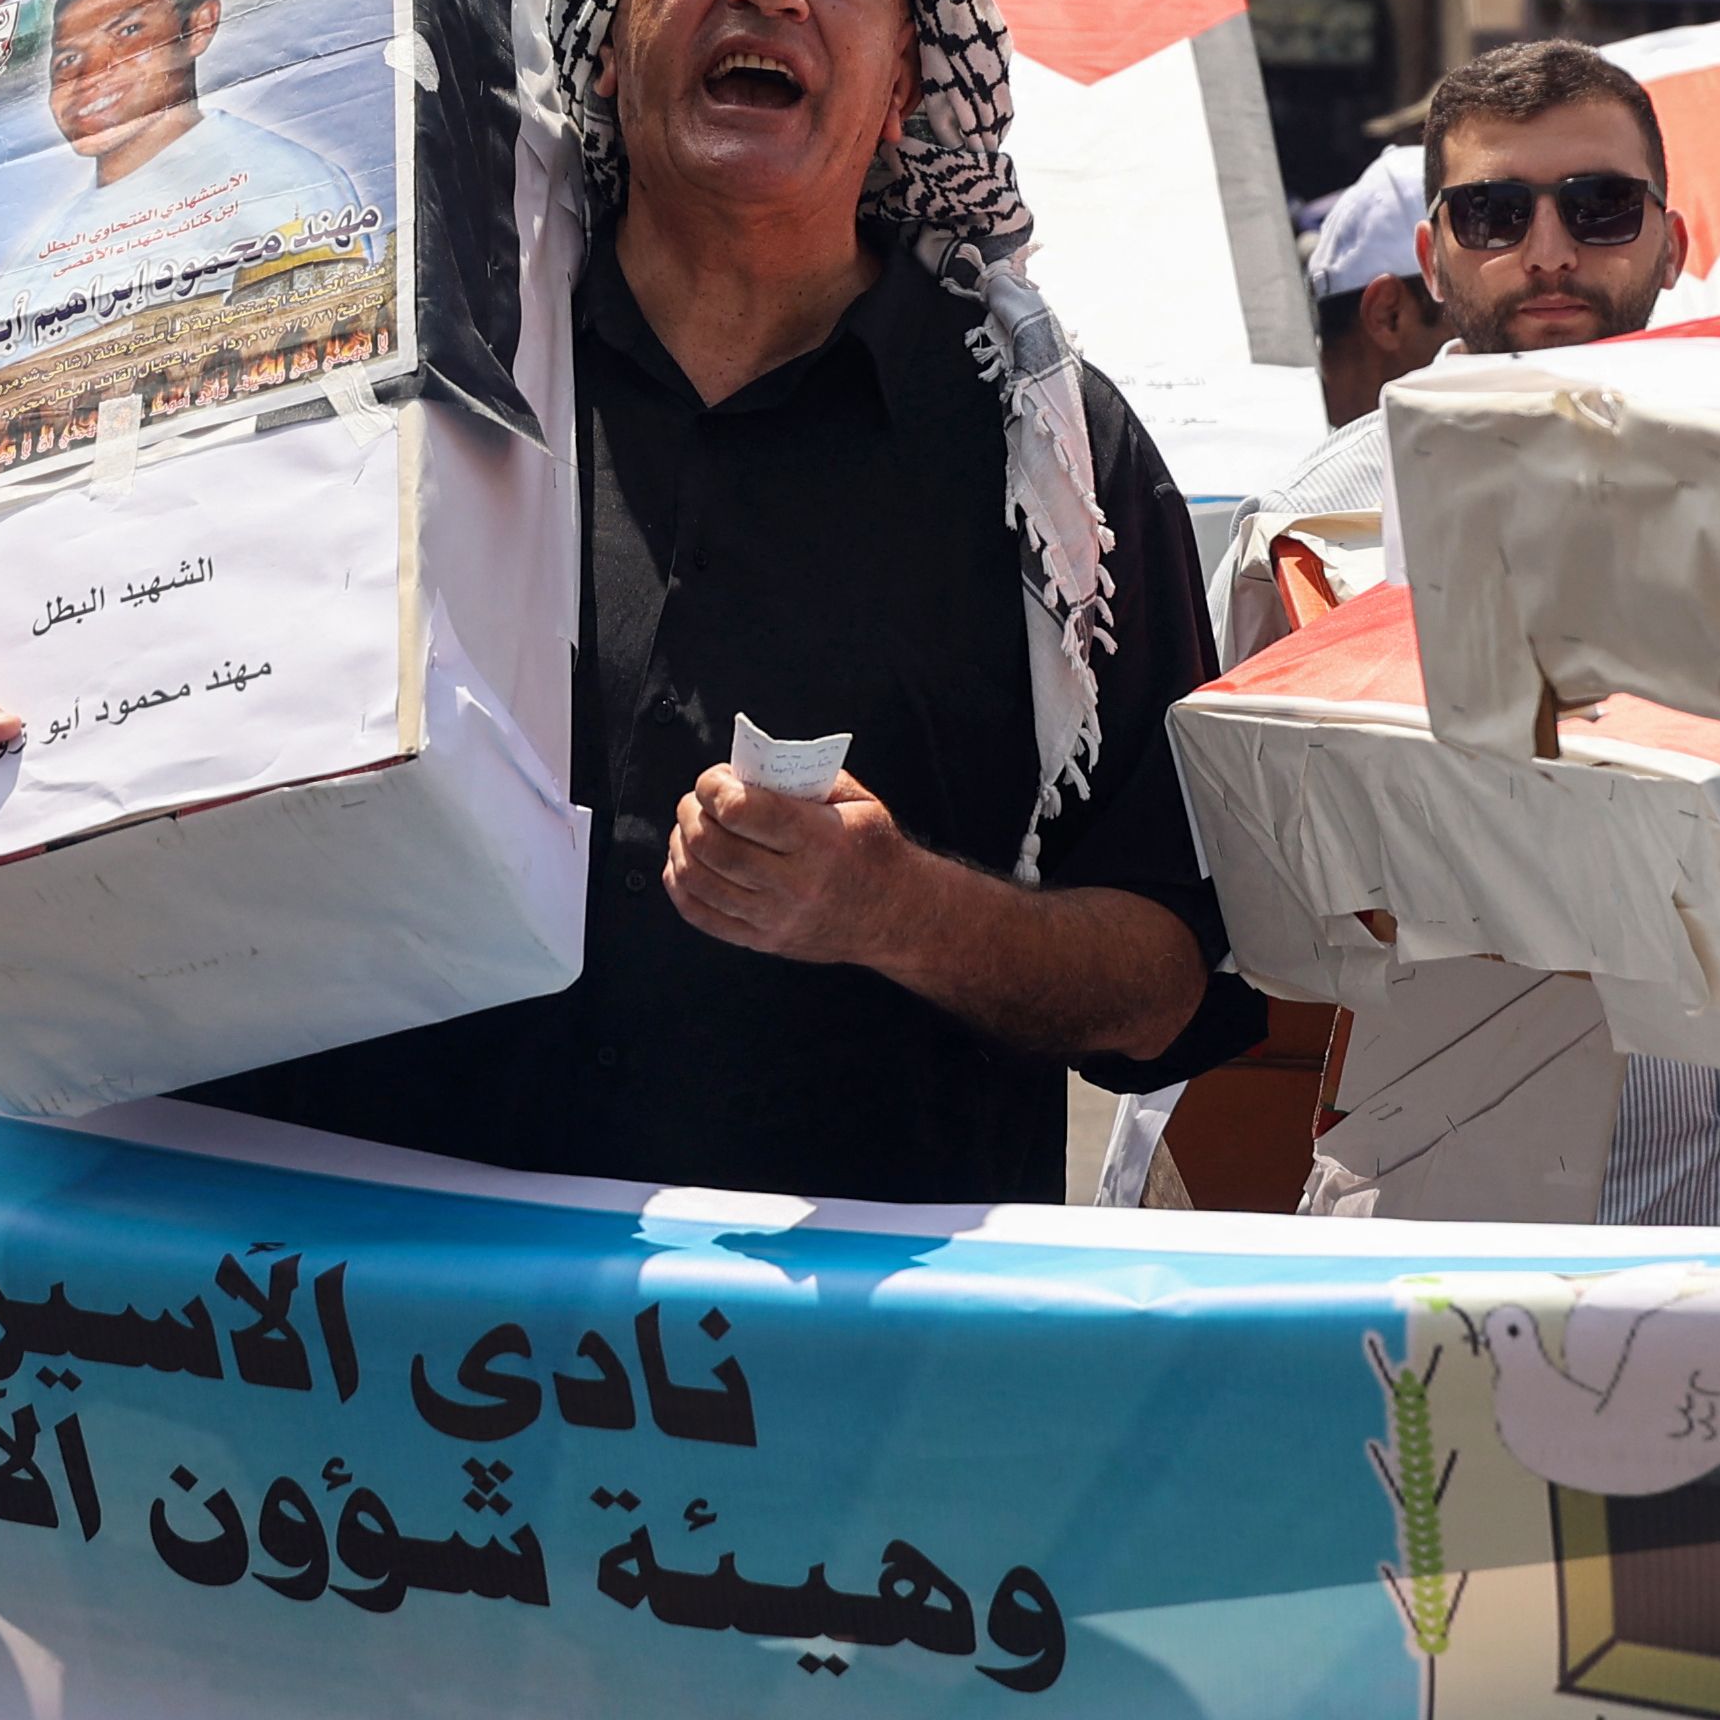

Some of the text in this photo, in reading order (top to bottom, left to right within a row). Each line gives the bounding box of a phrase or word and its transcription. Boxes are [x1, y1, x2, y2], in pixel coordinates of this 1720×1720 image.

[88, 208, 160, 245] الفتحاوي
[166, 210, 213, 239] كتائب
[292, 203, 381, 250] مهند
[38, 231, 87, 260] البطل
[116, 227, 164, 254] شهداء
[52, 242, 115, 278] الأقصى
[153, 233, 283, 297] محمود
[347, 265, 386, 286] منفذ
[33, 261, 147, 346] إبراهيم
[288, 276, 346, 304] العملية
[336, 292, 384, 320] بتاريخ
[93, 332, 164, 363] مستوطنة
[166, 322, 192, 342] في
[189, 340, 220, 361] على
[2, 393, 46, 420] محمود
[47, 380, 91, 405] البطل
[32, 556, 214, 636] الشهيد البطل
[205, 660, 272, 692] مهند
[95, 681, 191, 725] محمود
[40, 696, 81, 745] أبو
[148, 1457, 551, 1614] شؤون
[589, 1486, 1066, 1693] وهيئة
